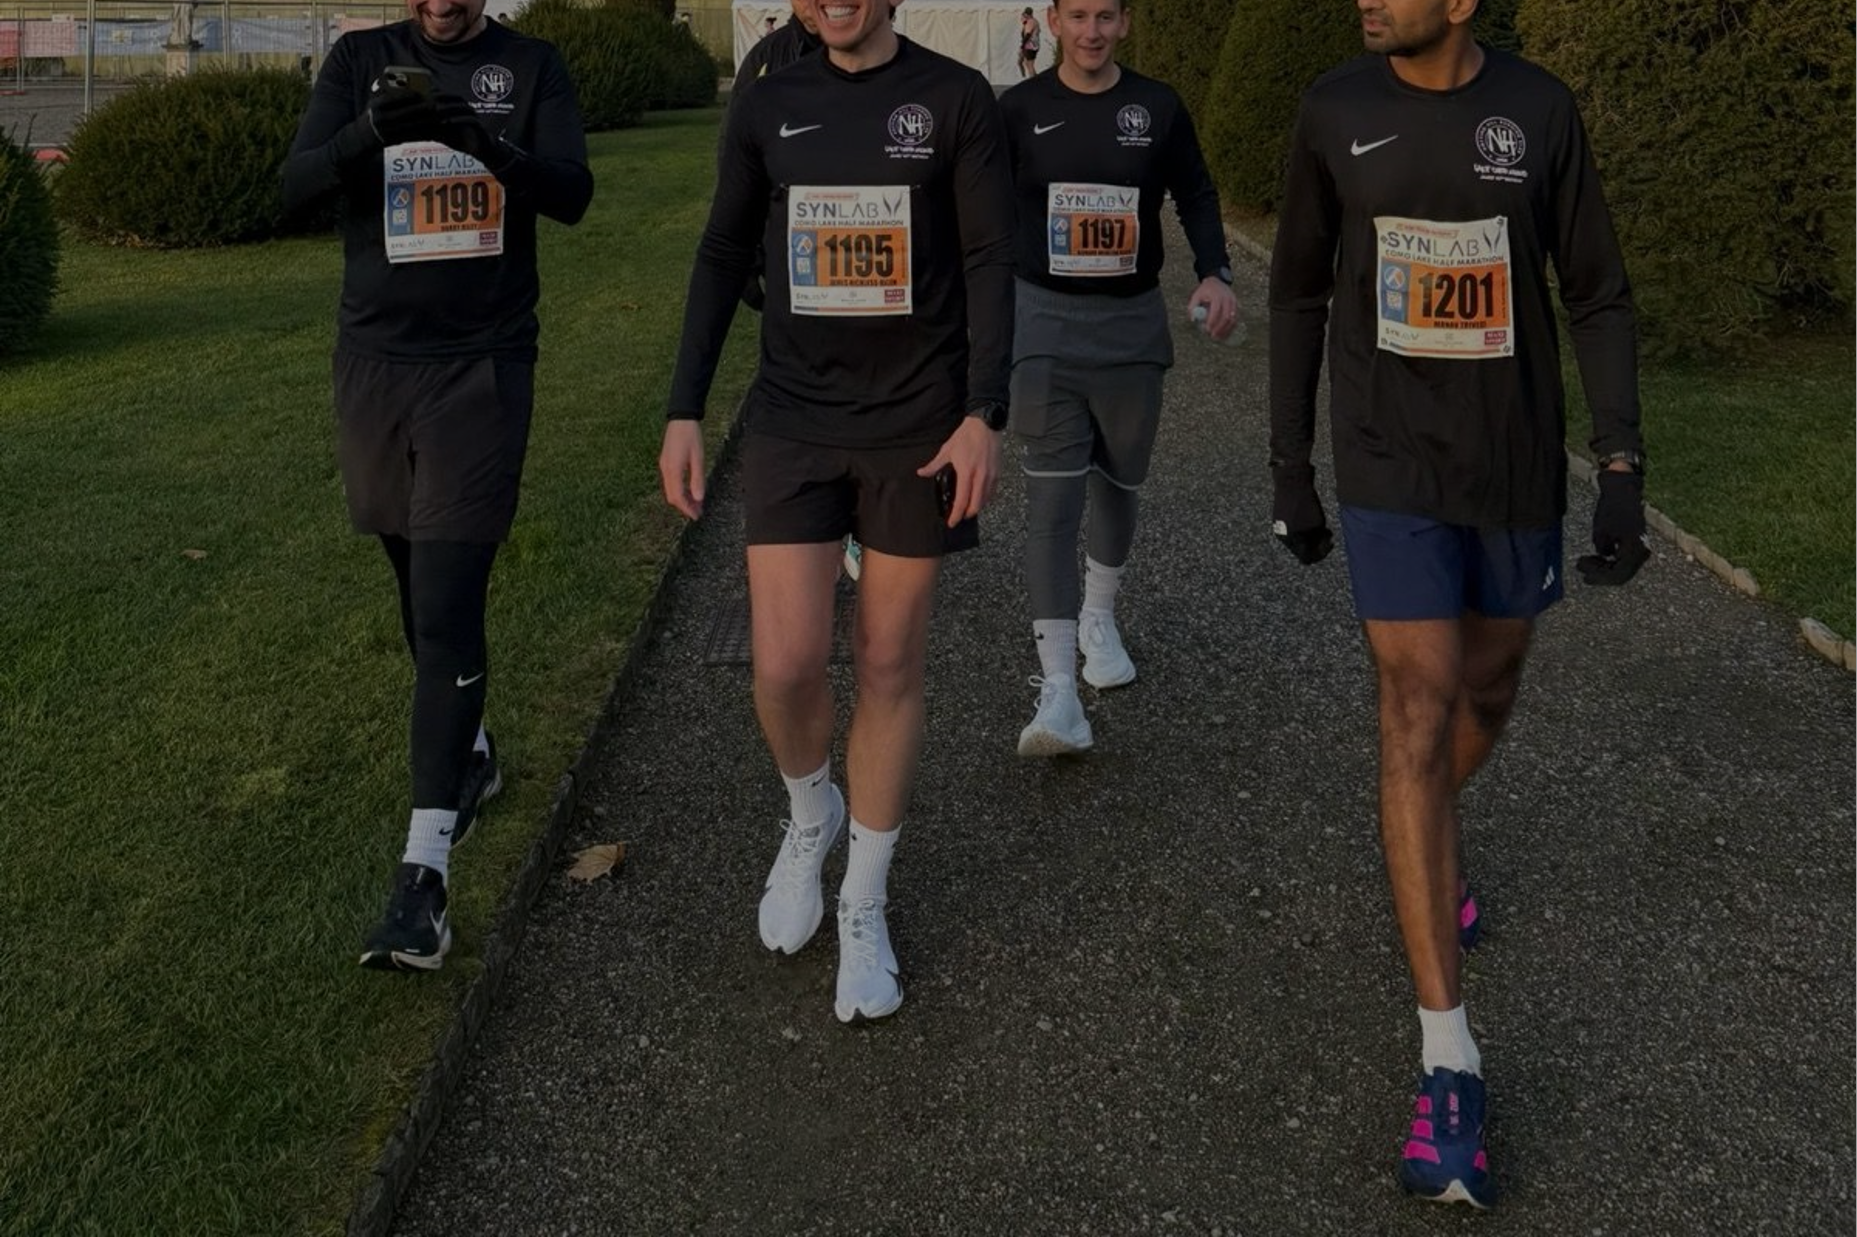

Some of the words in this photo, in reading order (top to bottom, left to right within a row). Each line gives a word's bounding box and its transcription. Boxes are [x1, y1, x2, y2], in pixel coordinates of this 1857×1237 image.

[898, 113, 924, 137] NH
[1487, 127, 1517, 157] NH
[392, 154, 476, 173] SYNLAB
[415, 171, 433, 180] LAKE
[421, 181, 489, 224] 1199
[796, 202, 879, 218] SYNLAB
[1054, 194, 1116, 208] SYNLAB
[858, 219, 904, 227] MARATHON
[1079, 218, 1126, 249] 1197
[824, 234, 893, 278] 1195
[1387, 231, 1480, 258] SYNLAB
[1412, 254, 1431, 264] LAKE
[1433, 258, 1455, 267] HALF
[1456, 255, 1504, 267] MARATHON
[1418, 272, 1493, 320] 1201
